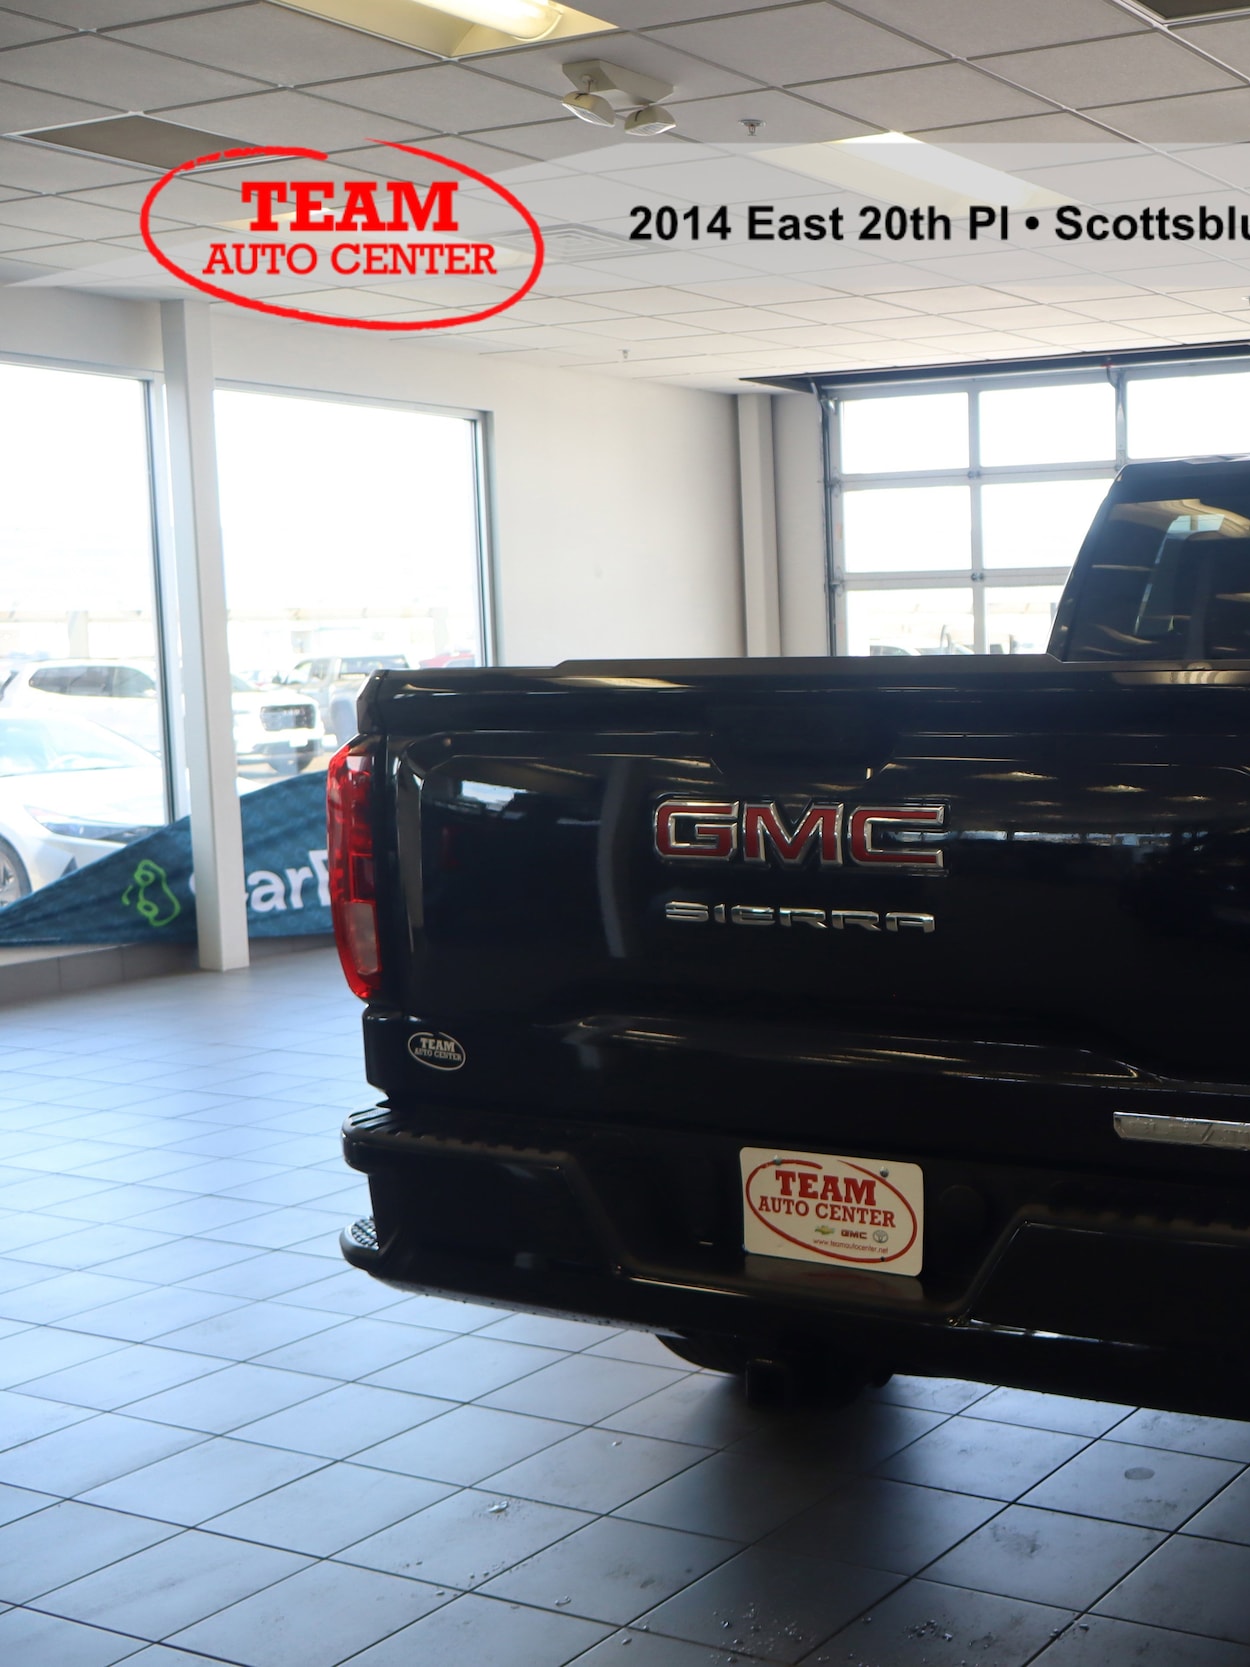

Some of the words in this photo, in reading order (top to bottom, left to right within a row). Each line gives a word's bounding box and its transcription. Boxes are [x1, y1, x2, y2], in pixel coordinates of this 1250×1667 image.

[654, 799, 945, 869] GMC
[665, 900, 936, 933] SIERRA
[414, 1047, 433, 1057] AUTO
[434, 1051, 462, 1061] CENTER
[420, 1037, 456, 1053] TEAM
[775, 1170, 877, 1206] TEAM
[758, 1195, 810, 1217] AUTO
[815, 1202, 896, 1228] CENTER
[840, 1229, 868, 1240] GMC
